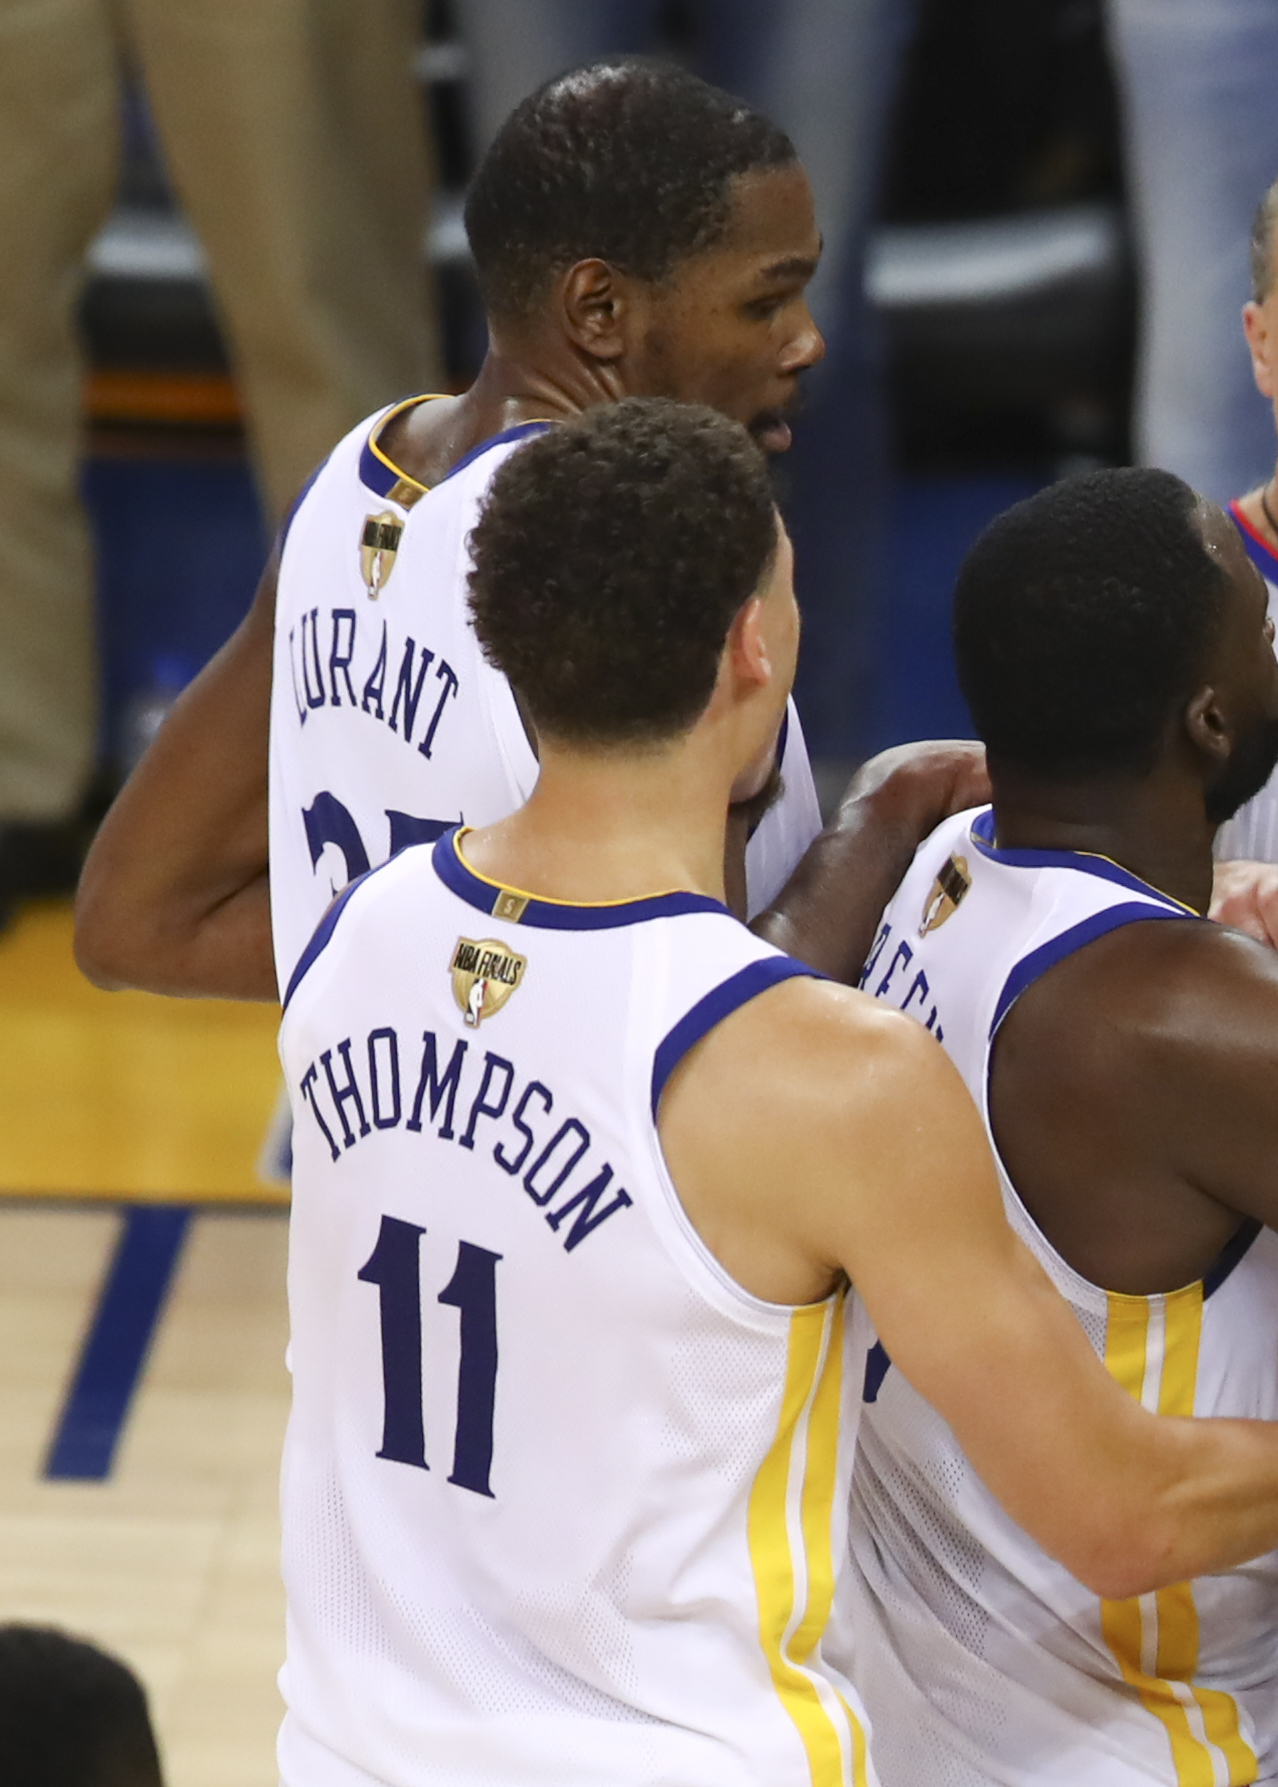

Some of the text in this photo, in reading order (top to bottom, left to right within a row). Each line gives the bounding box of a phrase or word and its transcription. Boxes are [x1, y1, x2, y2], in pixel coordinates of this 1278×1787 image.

[289, 606, 459, 761] URANT
[453, 943, 521, 985] NBA FINALS
[300, 1026, 633, 1253] THOMPSON
[357, 1214, 503, 1499] 11
